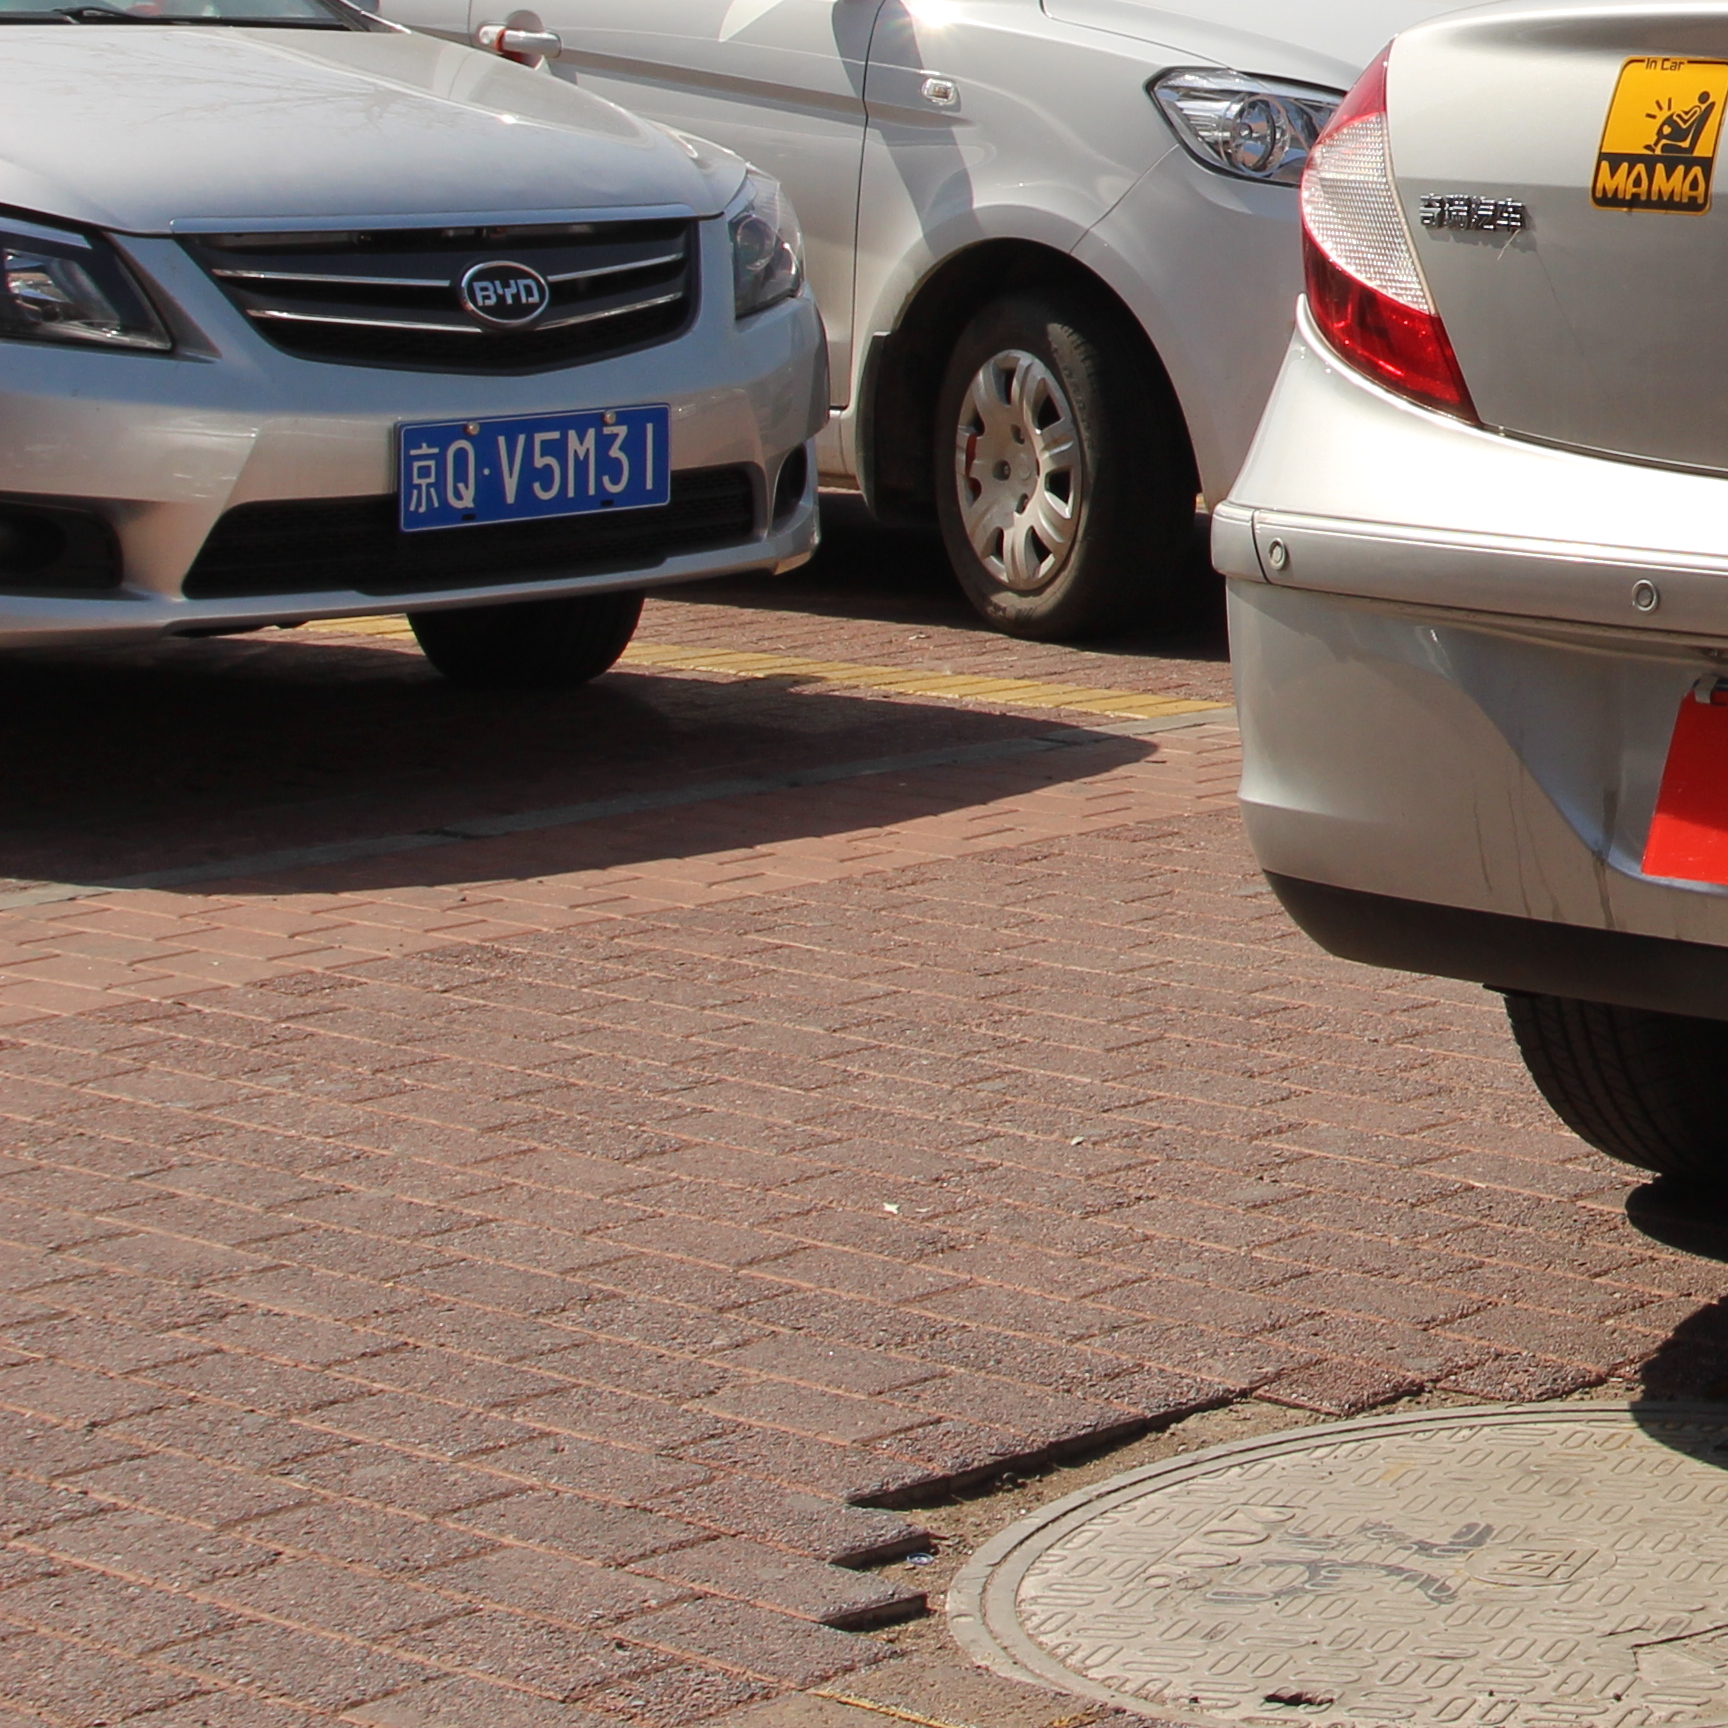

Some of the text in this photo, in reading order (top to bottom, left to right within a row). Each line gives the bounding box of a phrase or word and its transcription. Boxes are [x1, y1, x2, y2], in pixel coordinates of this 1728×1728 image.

[1646, 58, 1685, 71] In Car
[1595, 160, 1706, 204] MAMA
[473, 278, 540, 307] BYD
